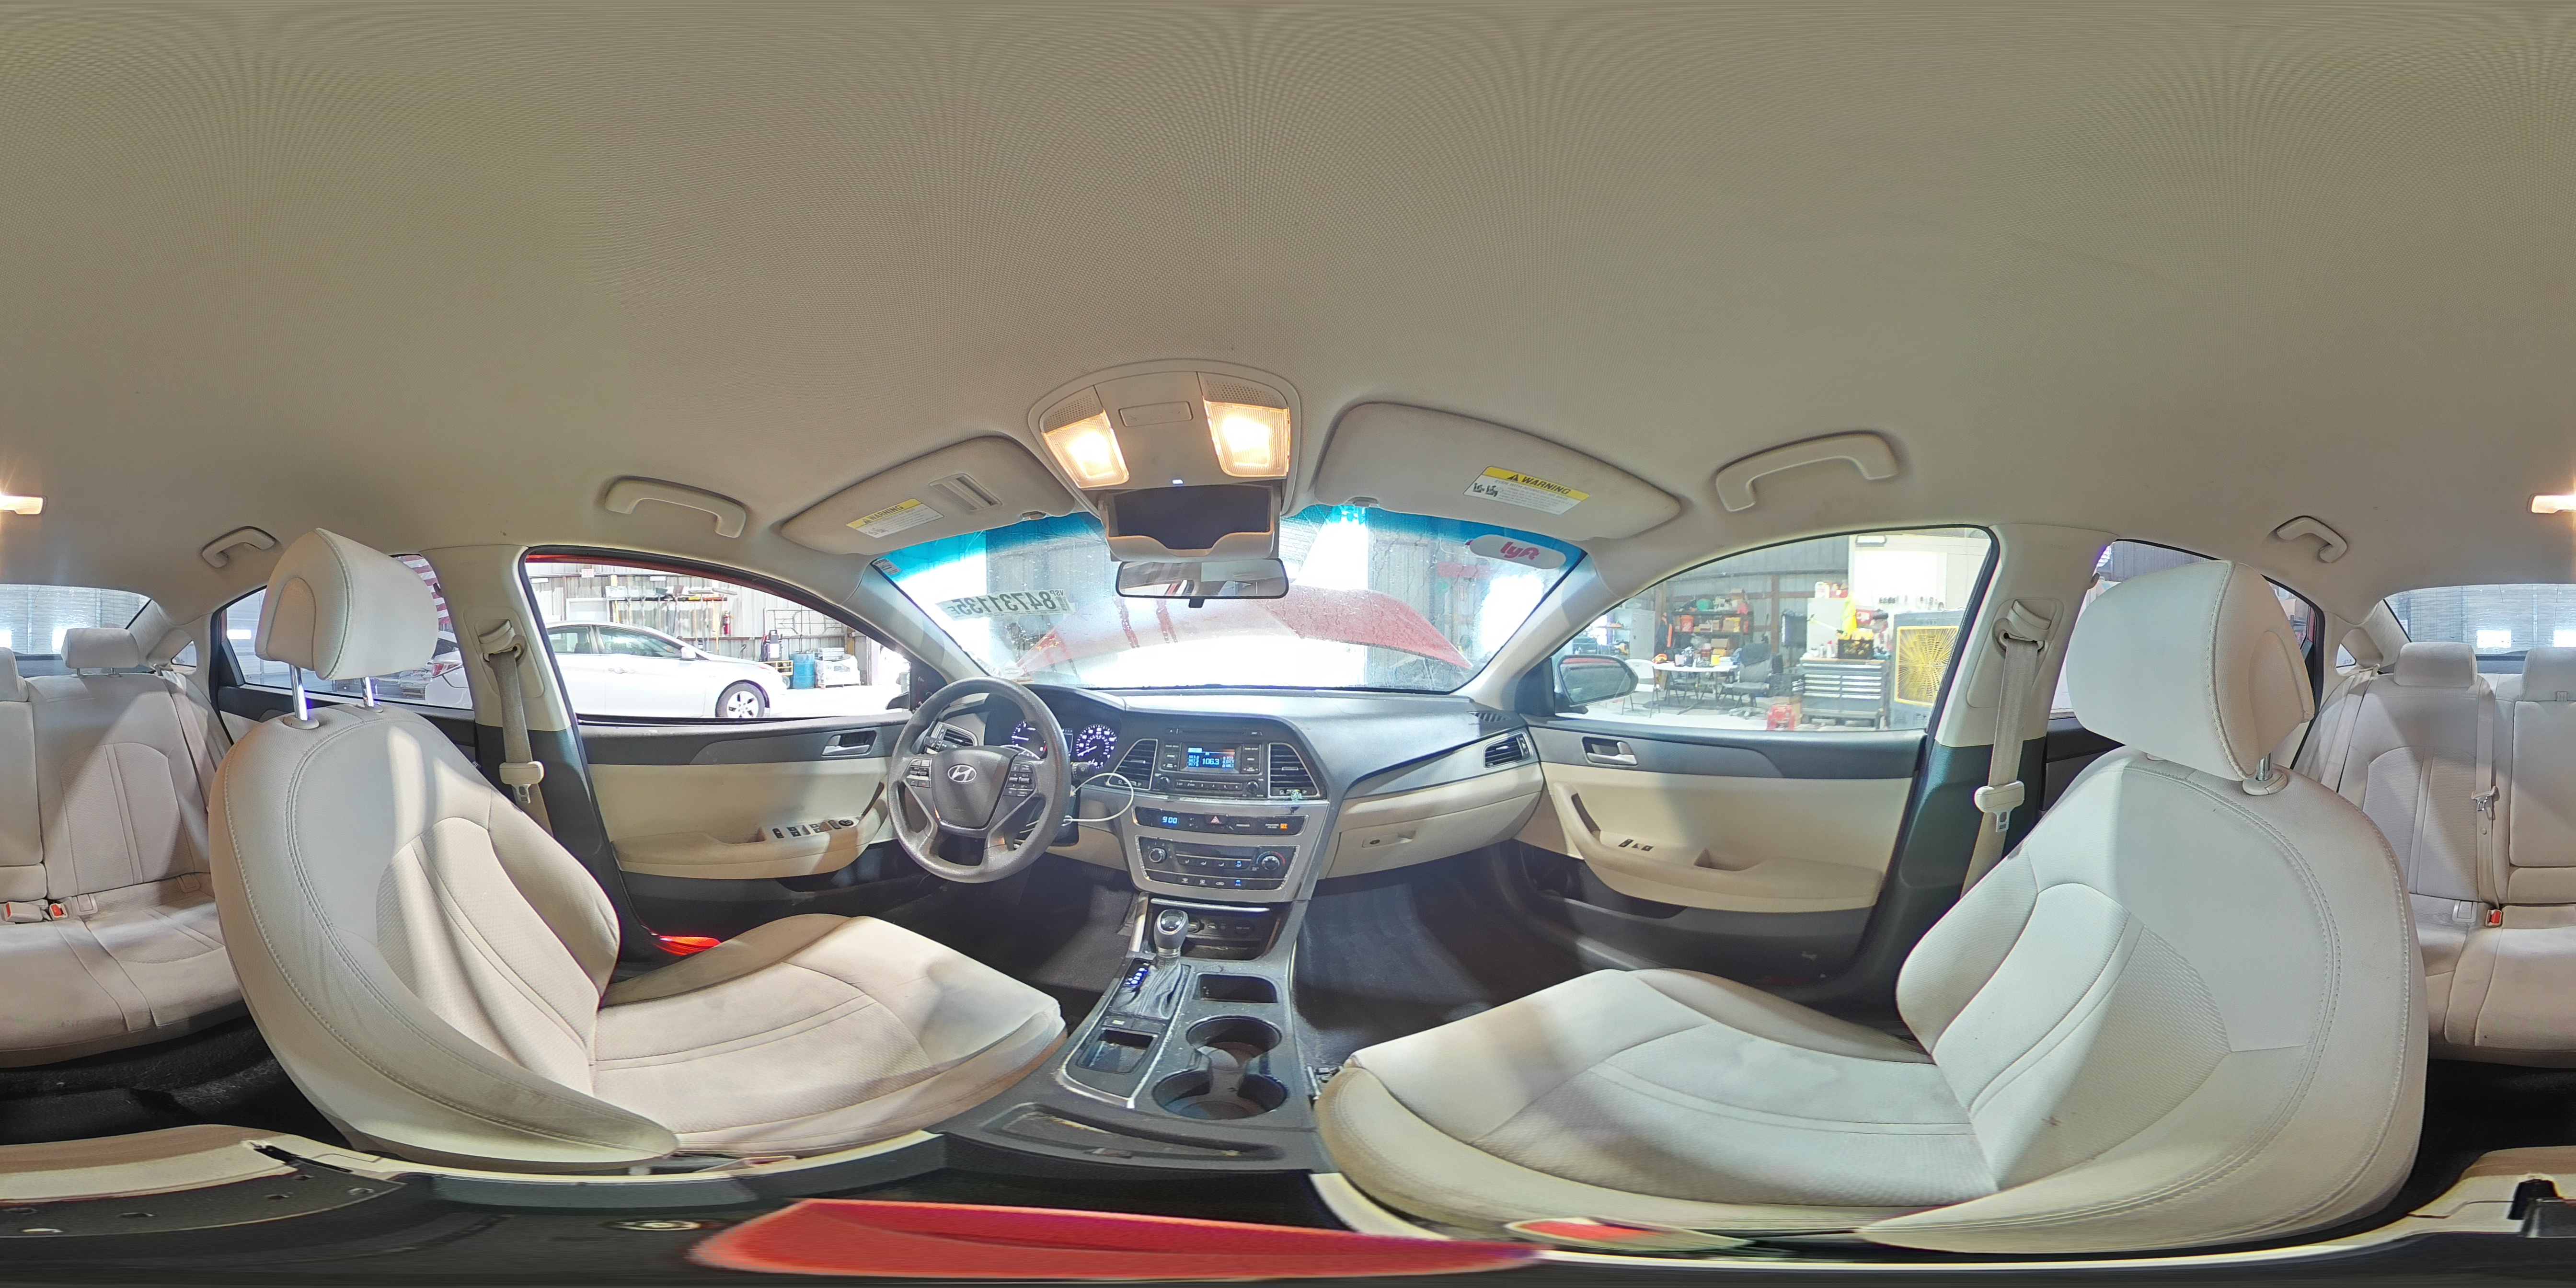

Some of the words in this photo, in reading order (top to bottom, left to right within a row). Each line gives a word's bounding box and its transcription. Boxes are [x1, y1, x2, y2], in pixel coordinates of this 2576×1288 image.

[1522, 476, 1571, 494] WARNING
[867, 505, 905, 520] WARNING
[1500, 541, 1540, 560] lyft
